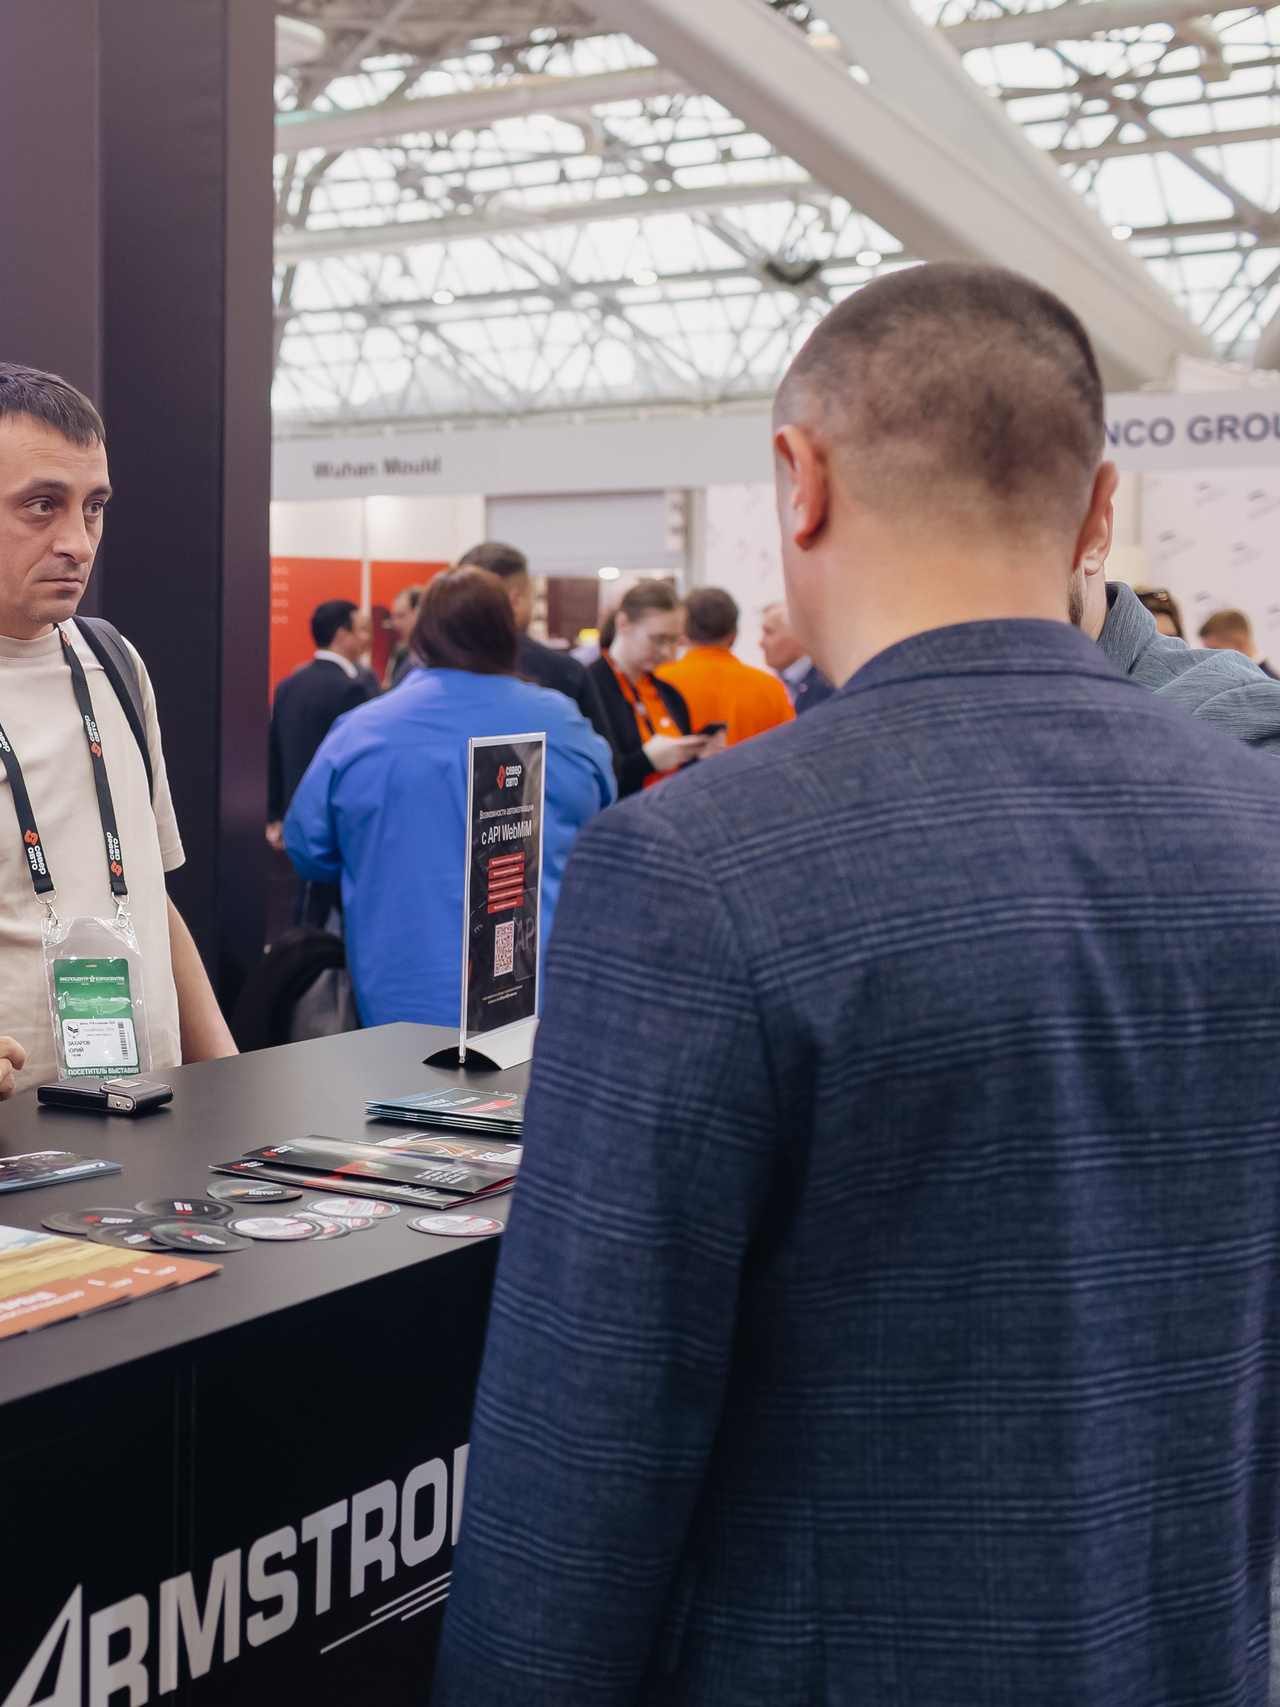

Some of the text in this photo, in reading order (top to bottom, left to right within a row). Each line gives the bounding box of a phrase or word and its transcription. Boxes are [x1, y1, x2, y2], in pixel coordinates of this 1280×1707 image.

[312, 456, 442, 479] Wuhan Mould
[505, 765, 522, 777] север
[505, 777, 518, 787] авто
[106, 831, 115, 861] север
[488, 825, 501, 844] API
[28, 847, 38, 871] авто
[34, 845, 47, 875] север
[113, 837, 121, 861] авто
[108, 1067, 139, 1075] ВЫСТАВКИ
